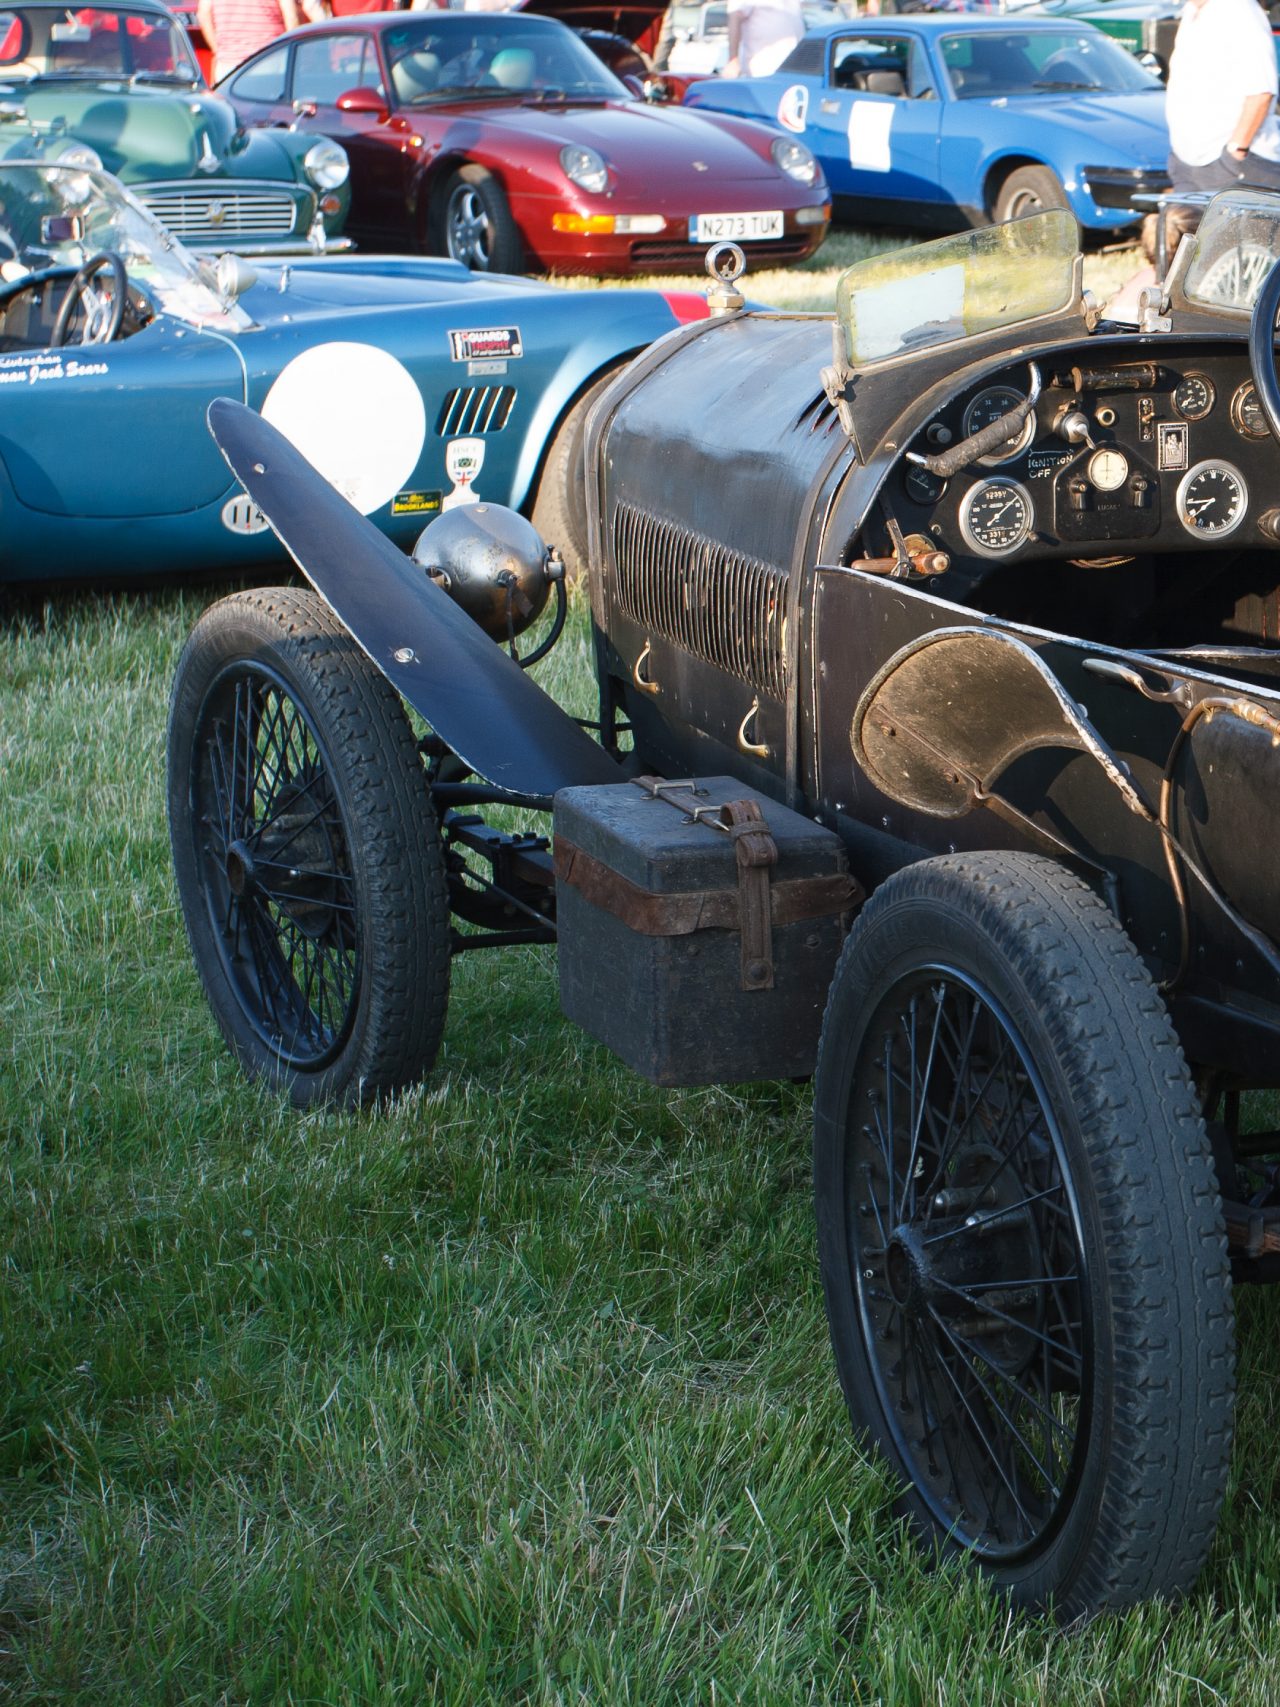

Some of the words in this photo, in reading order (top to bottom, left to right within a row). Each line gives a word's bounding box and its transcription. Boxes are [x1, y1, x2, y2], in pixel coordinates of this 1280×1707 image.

[703, 217, 745, 237] N273
[752, 215, 779, 235] TUK
[1028, 454, 1074, 469] IGNITION
[1028, 468, 1051, 479] OFF
